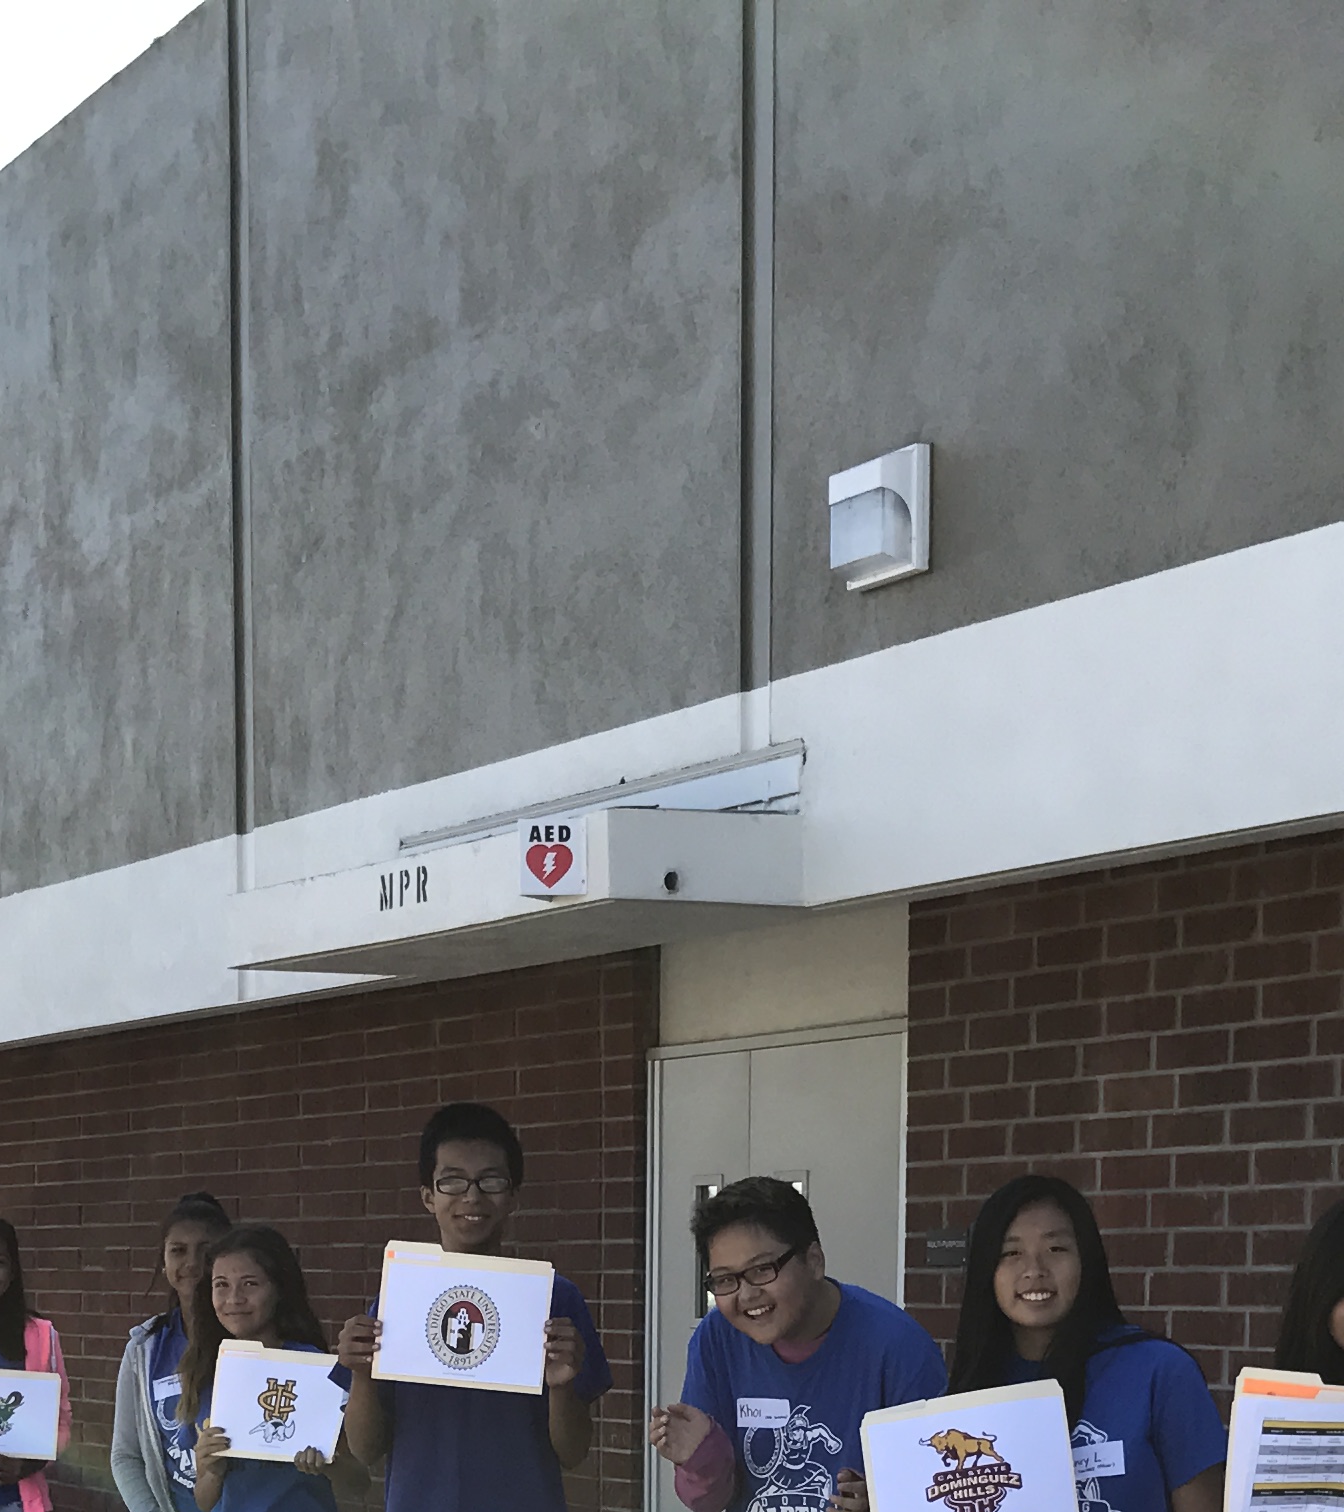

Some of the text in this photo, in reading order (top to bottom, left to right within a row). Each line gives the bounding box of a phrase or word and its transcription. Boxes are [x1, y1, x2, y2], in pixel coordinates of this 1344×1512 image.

[529, 825, 571, 843] AED
[379, 866, 428, 912] MPR
[430, 1290, 496, 1356] SAN DIEGO STATE UNIVERSITY
[448, 1356, 472, 1366] 1897
[937, 1465, 1007, 1482] CAL STATE
[927, 1474, 1020, 1500] DOMINGUEZ
[953, 1484, 996, 1500] HILLS
